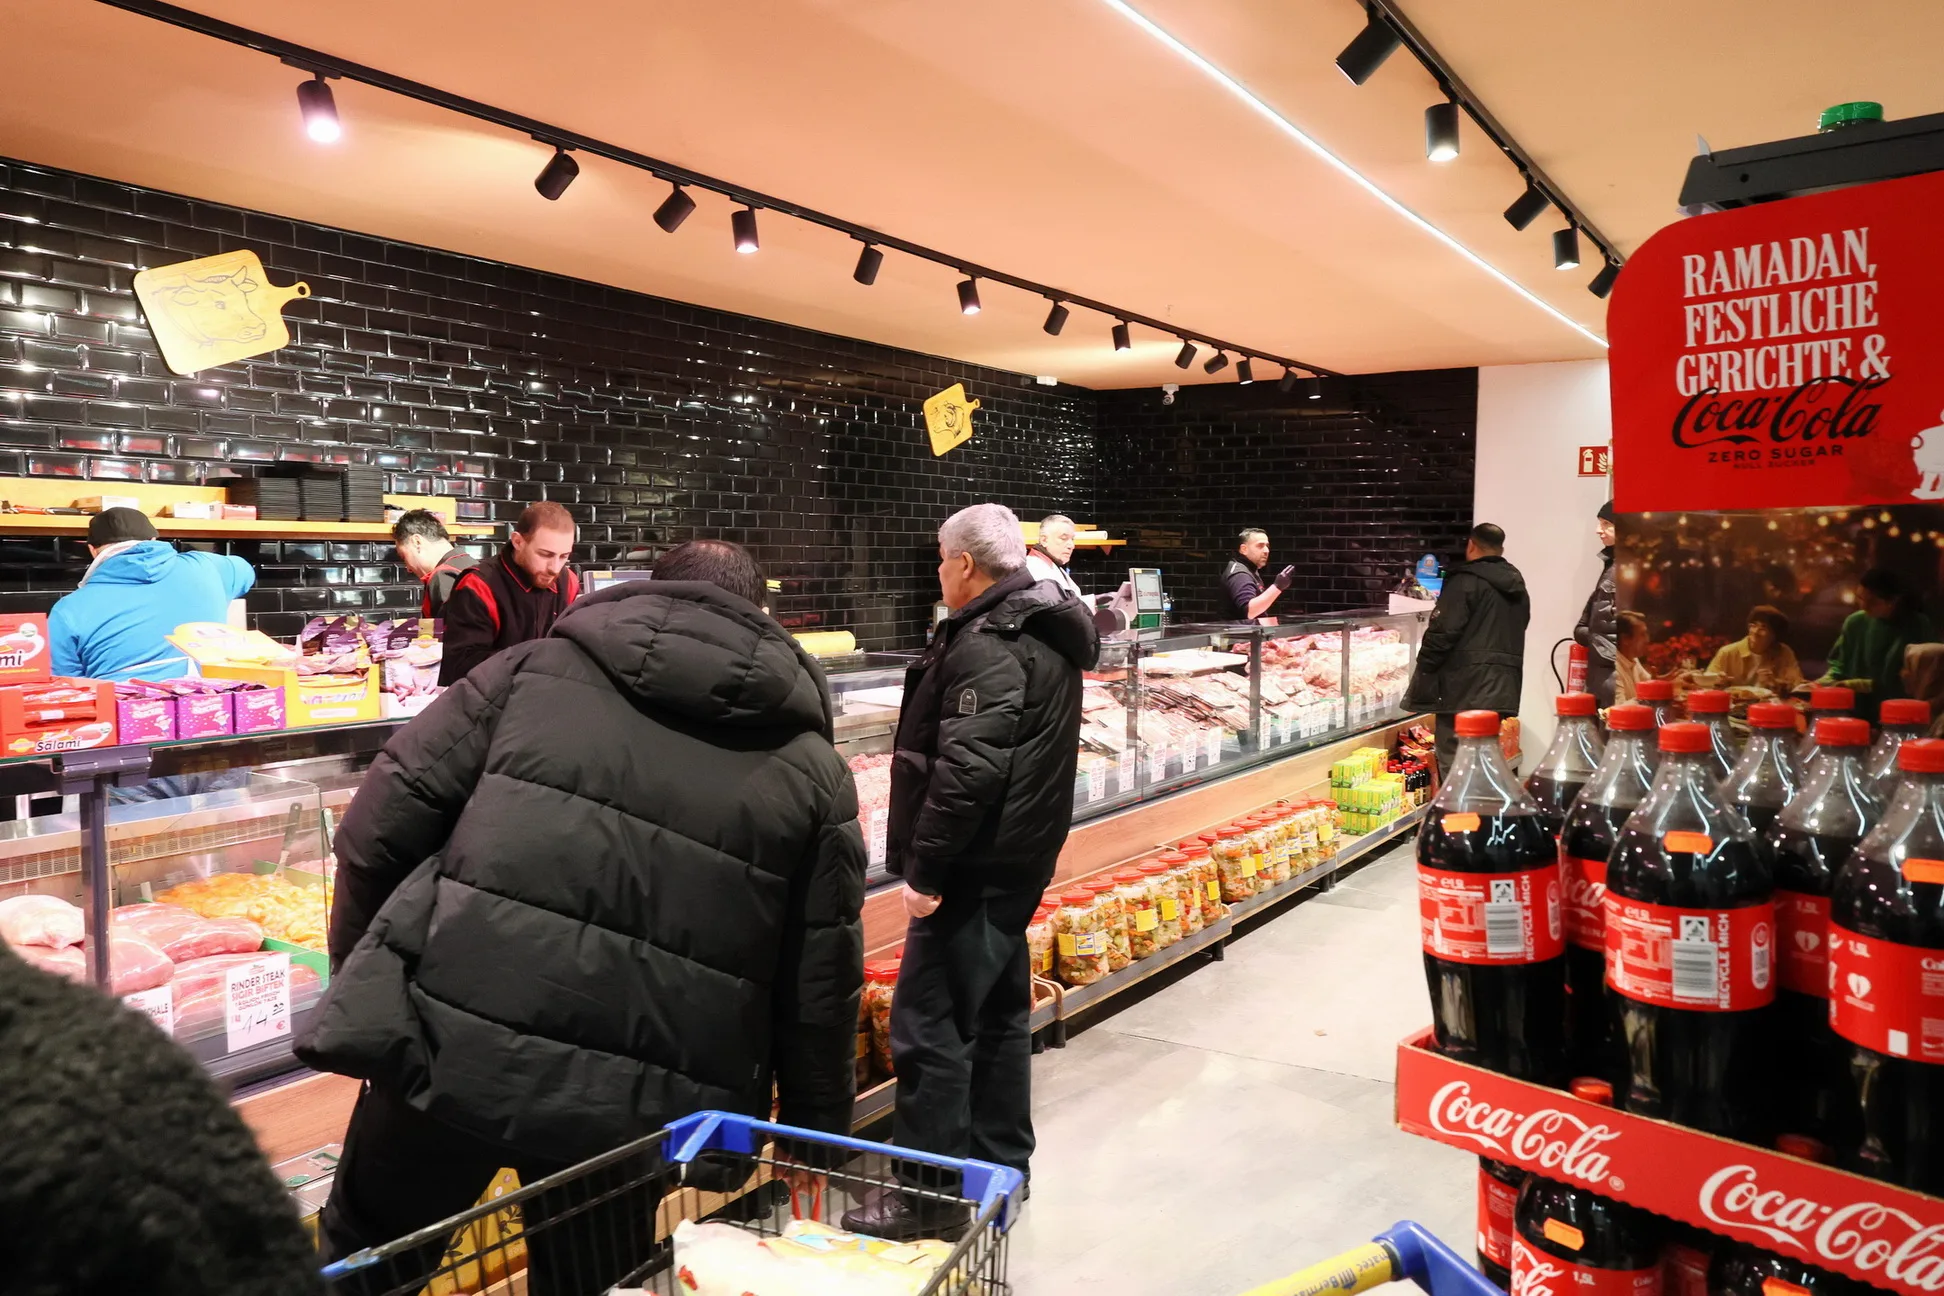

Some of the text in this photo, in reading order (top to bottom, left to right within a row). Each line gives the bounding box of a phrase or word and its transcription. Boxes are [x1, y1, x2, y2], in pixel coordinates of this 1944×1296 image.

[1682, 227, 1877, 298] RAMADAN,
[1684, 281, 1879, 347] FESTLICHE
[1675, 334, 1891, 397] GERICHTE &
[1671, 372, 1895, 449] Coca-Cola
[1708, 445, 1844, 463] ZERO SUGAR
[0, 650, 22, 666] mi
[36, 737, 82, 752] Salami
[1520, 874, 1535, 961] RECYCLE MICH
[231, 969, 286, 992] RINDER STEAK
[1718, 913, 1731, 1009] RECYCLE MICH
[1428, 1080, 1622, 1185] Coca-Cola
